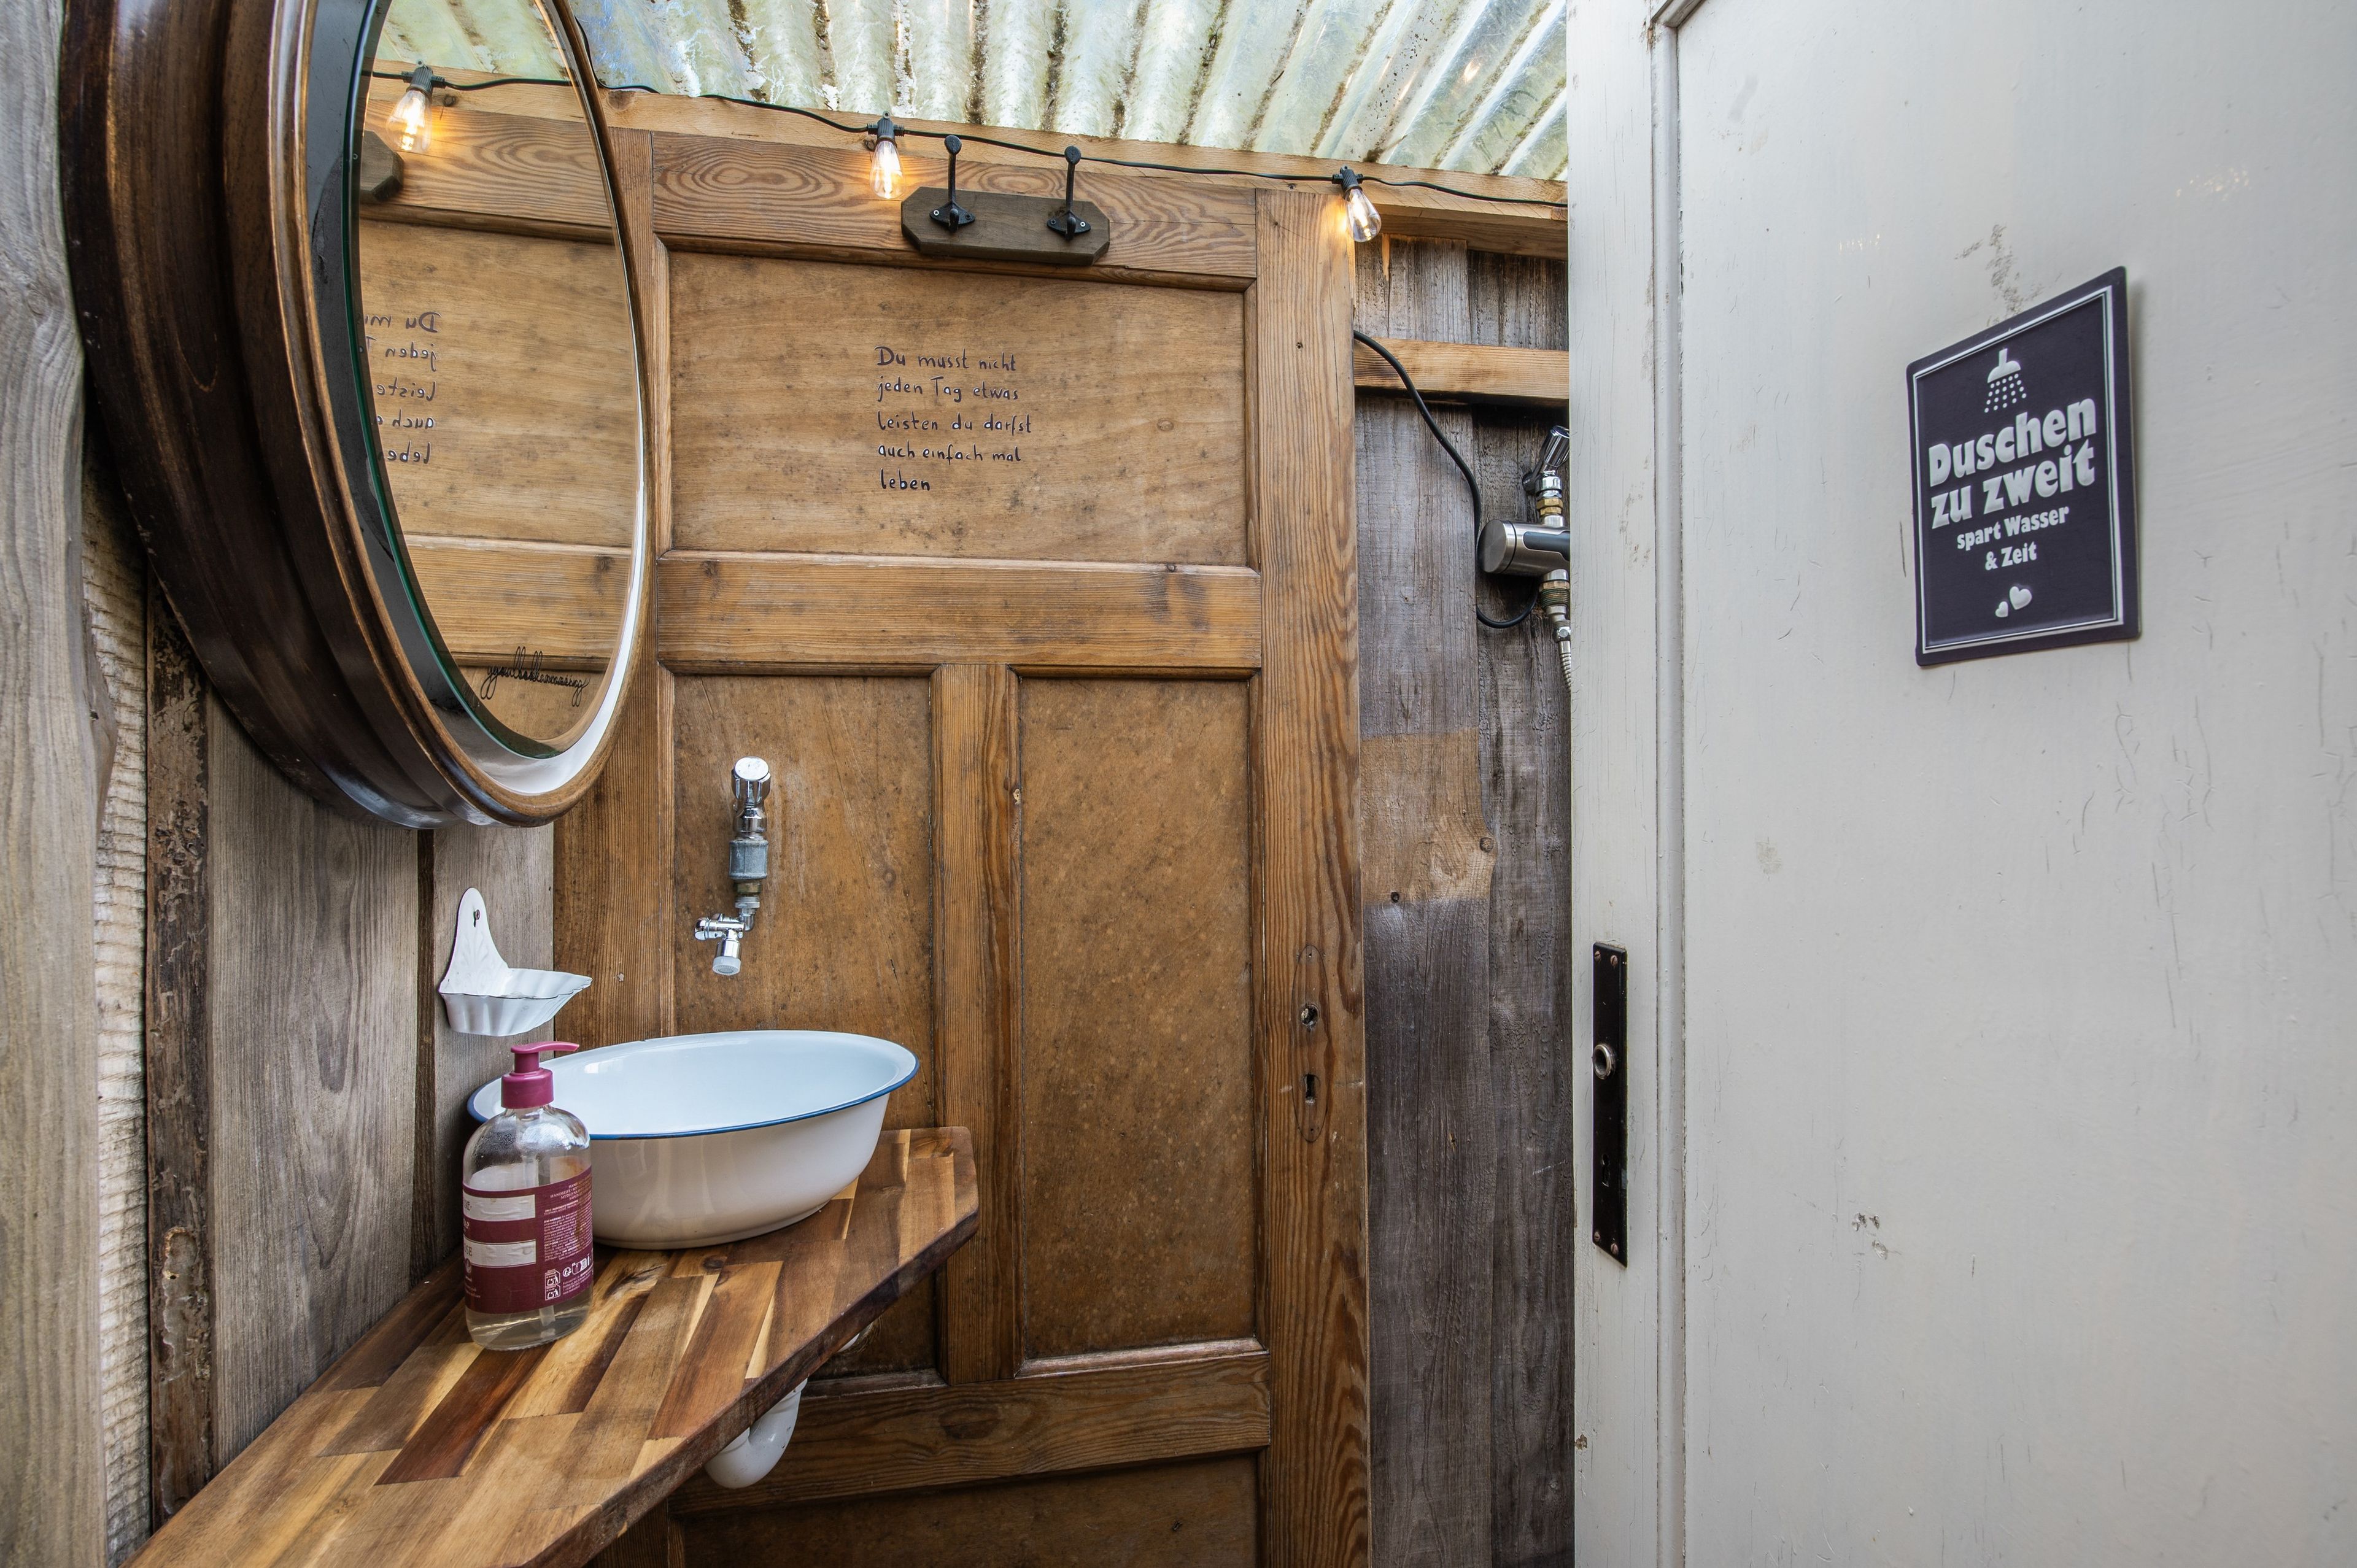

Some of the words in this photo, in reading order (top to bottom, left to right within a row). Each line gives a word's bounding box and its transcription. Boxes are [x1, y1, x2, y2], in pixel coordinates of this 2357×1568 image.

[874, 346, 905, 366] Du
[918, 349, 969, 369] musst
[979, 352, 1016, 371] nicht
[877, 376, 923, 402] jeden
[930, 376, 962, 403] Tag
[973, 380, 1018, 400] etwas
[878, 411, 938, 430] leisten
[951, 412, 972, 430] du
[984, 413, 1031, 436] darfst
[878, 439, 915, 458] auch
[923, 443, 983, 465] einfach
[992, 446, 1021, 462] mal
[1929, 398, 2096, 487] Duschen
[880, 468, 931, 490] leben
[1931, 485, 1972, 529] zu
[1983, 439, 2095, 514] zweit
[1957, 522, 2001, 551] spart
[2004, 506, 2070, 537] Wasser
[1985, 551, 1998, 571] &
[2001, 541, 2037, 567] Zeit
